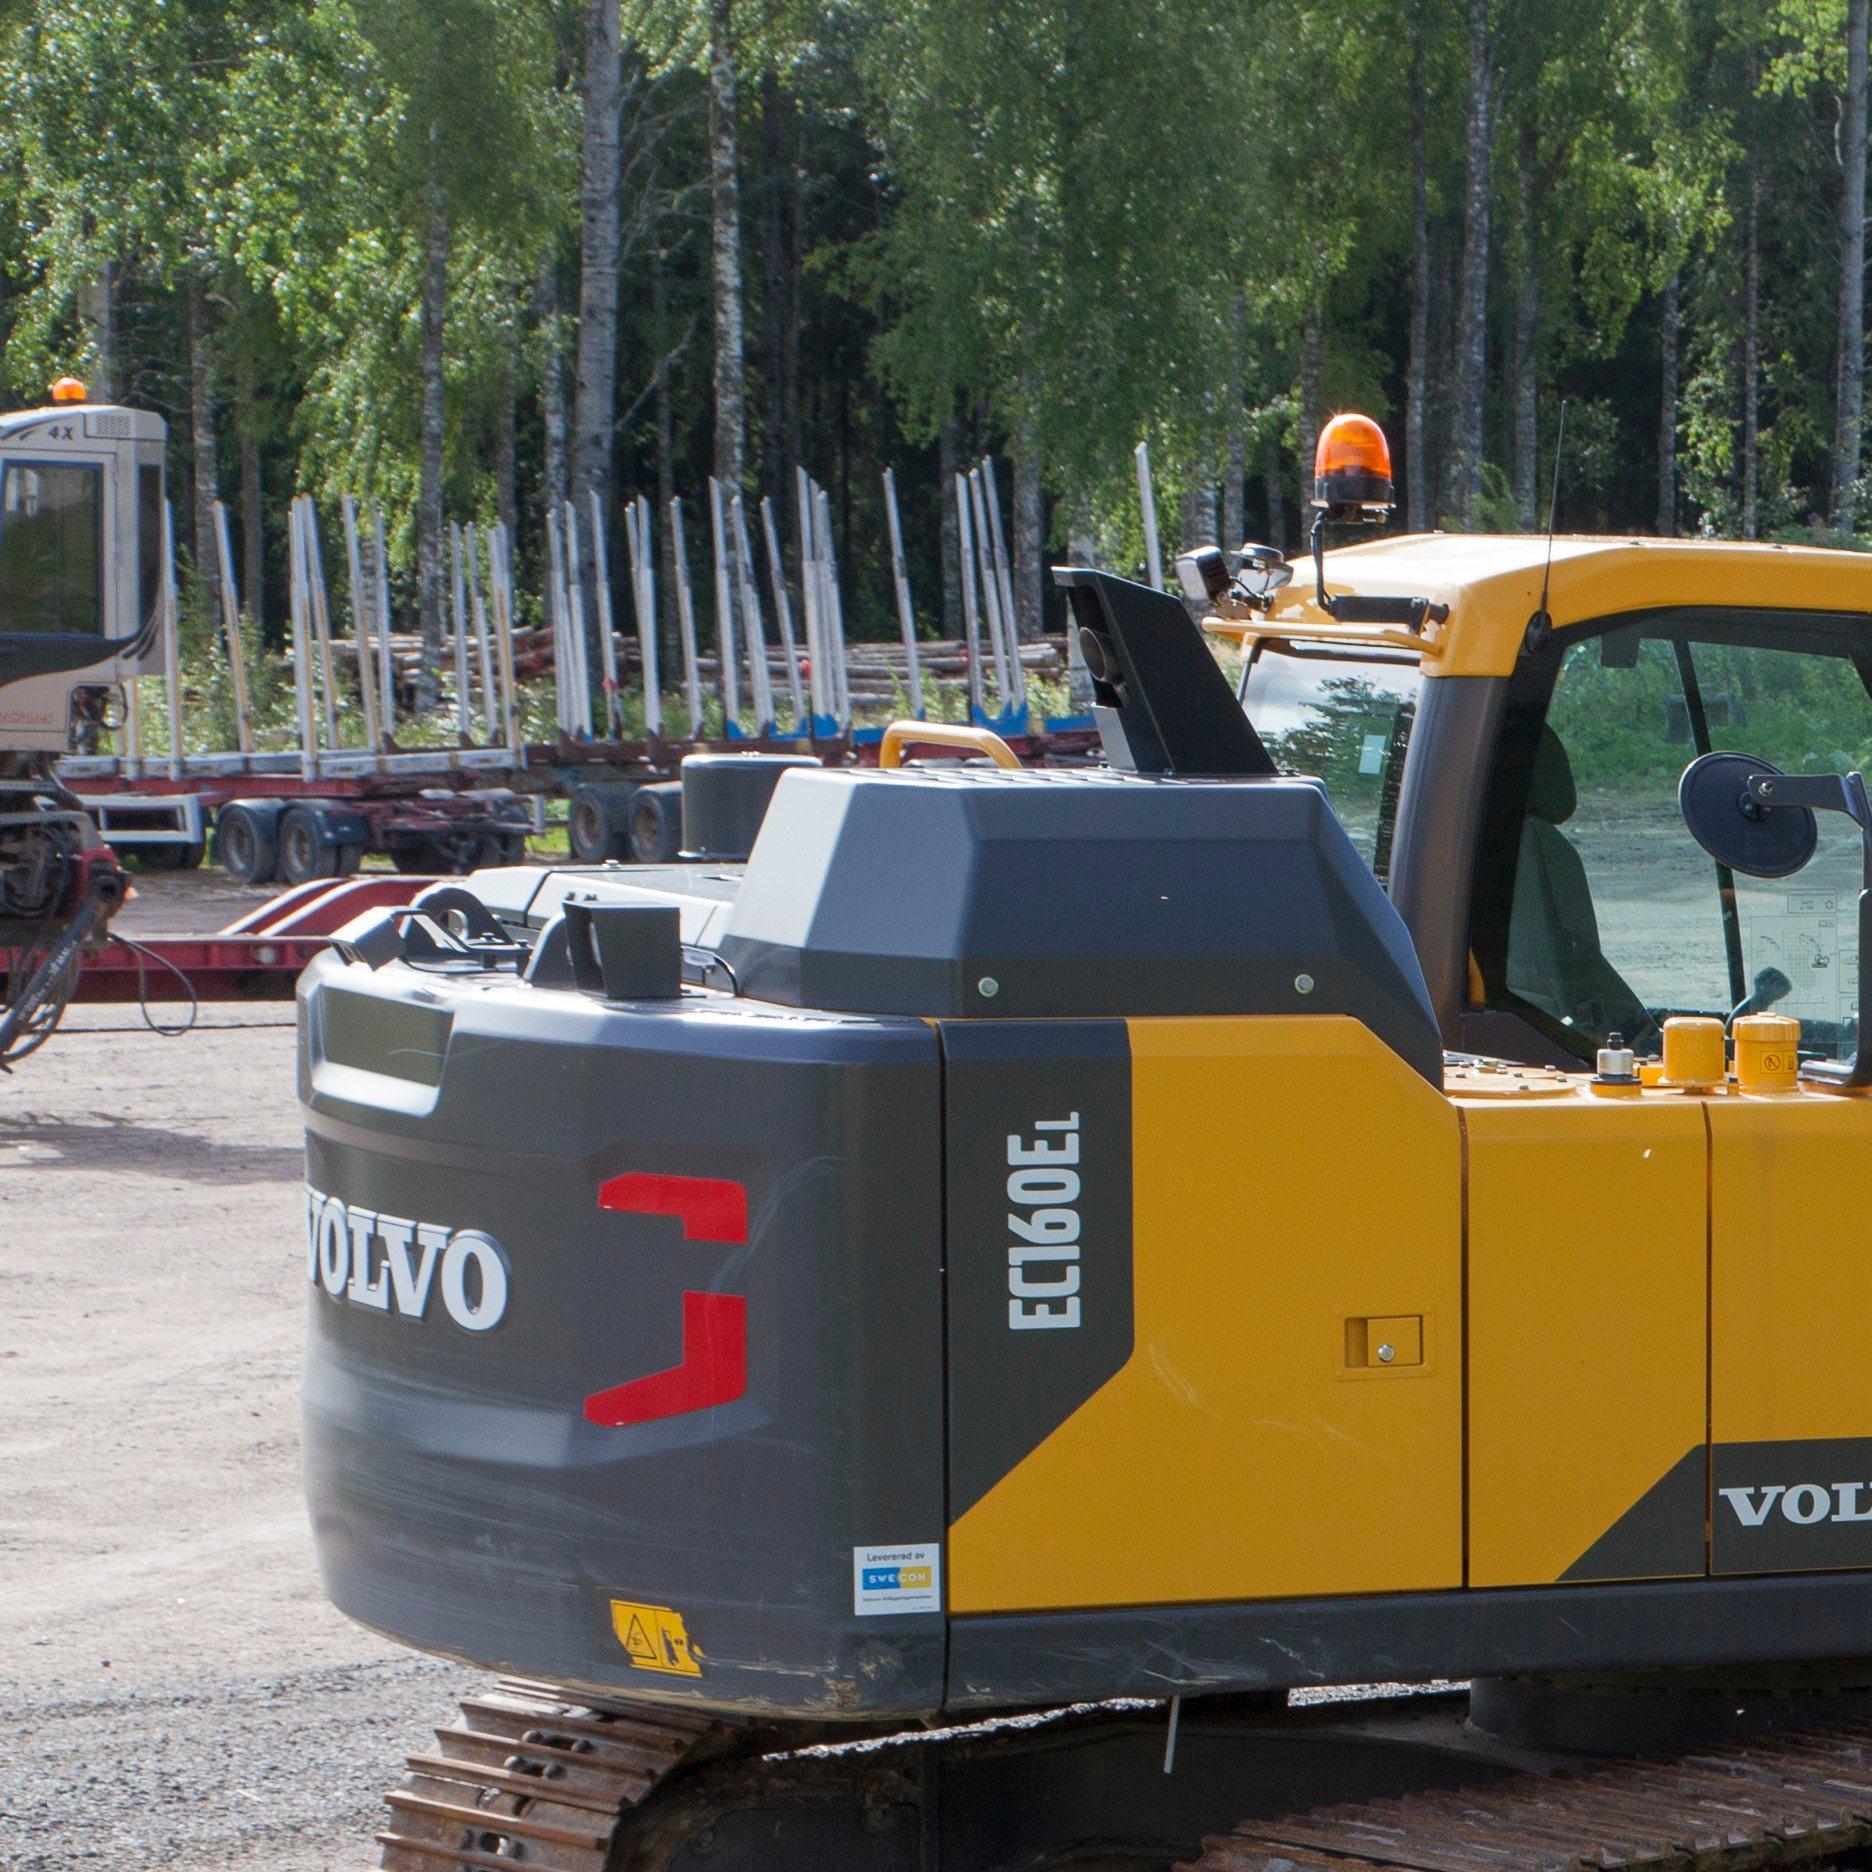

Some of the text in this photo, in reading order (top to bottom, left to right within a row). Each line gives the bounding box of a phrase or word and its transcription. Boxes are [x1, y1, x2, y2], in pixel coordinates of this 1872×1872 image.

[304, 1183, 510, 1332] VOLVO
[1007, 1112, 1081, 1330] EC160EL
[866, 1551, 926, 1562] Levererad av
